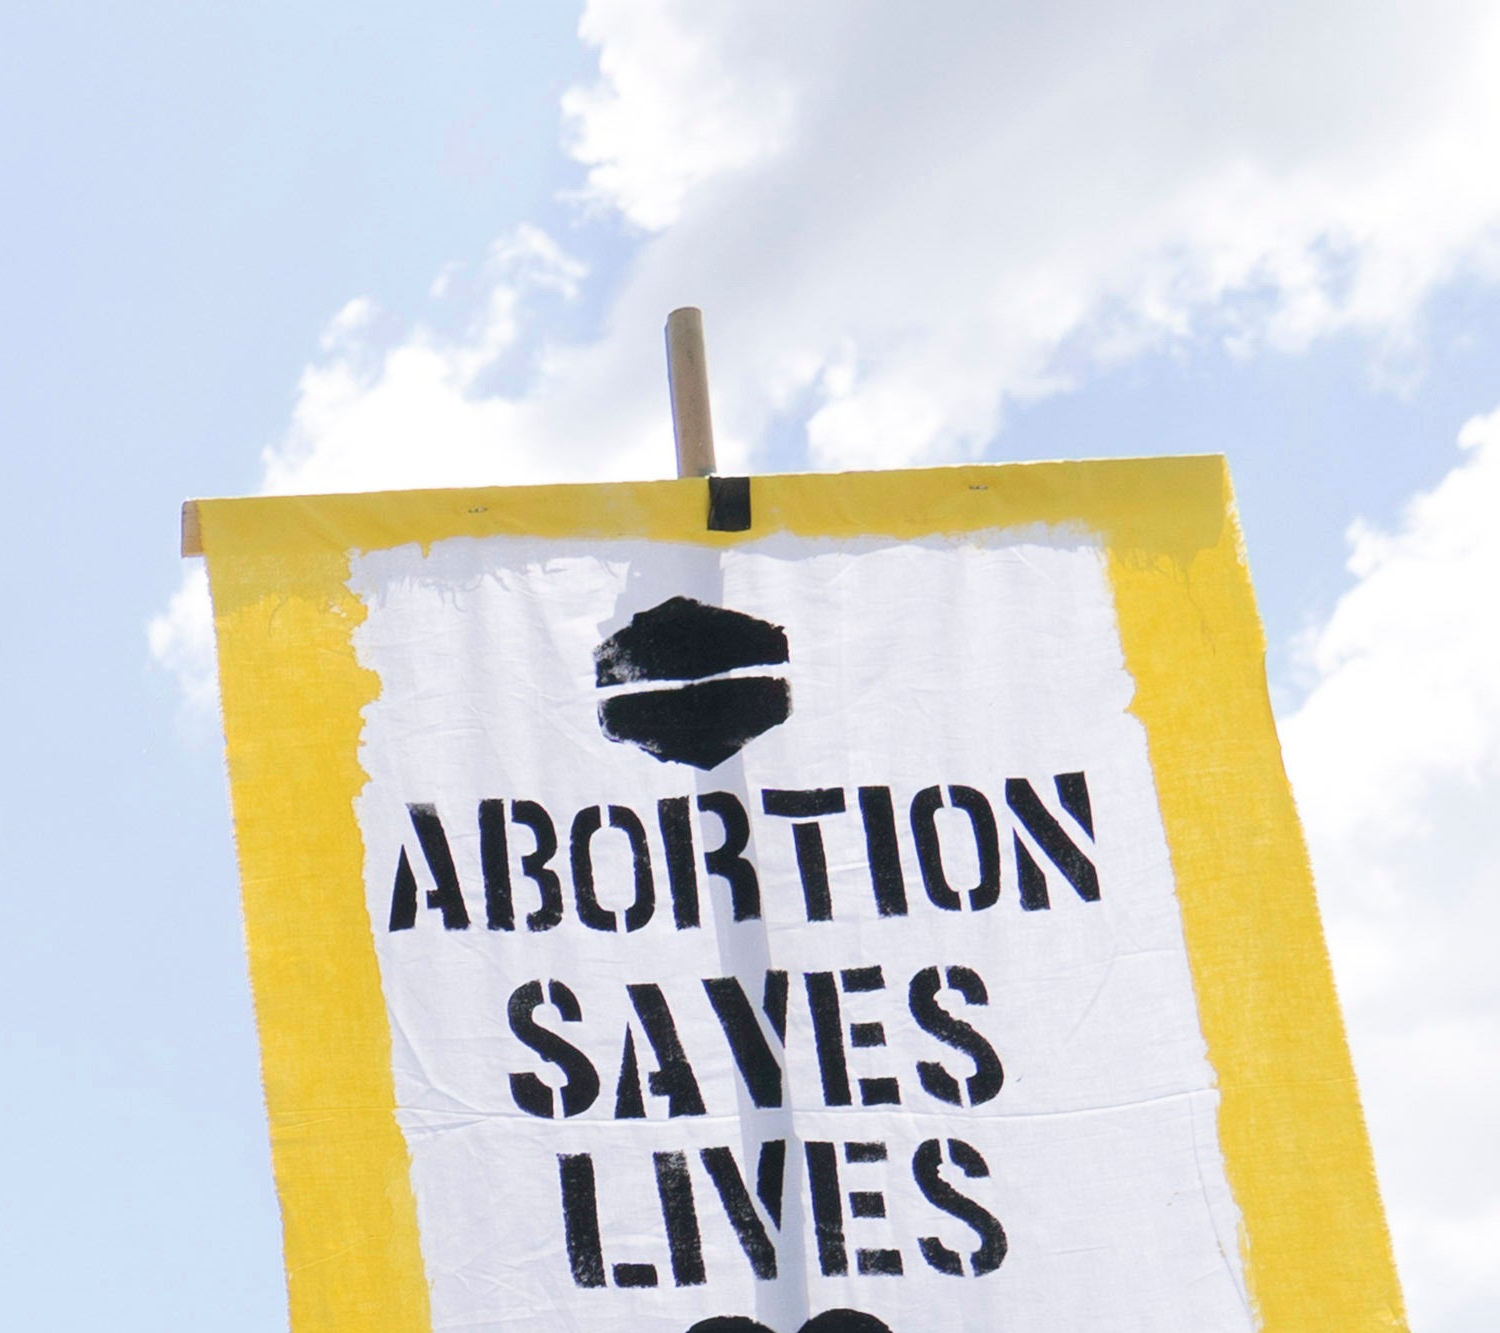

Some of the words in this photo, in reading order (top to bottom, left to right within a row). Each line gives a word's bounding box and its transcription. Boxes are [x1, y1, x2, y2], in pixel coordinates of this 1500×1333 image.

[387, 771, 1103, 935] ABORTION
[506, 964, 1005, 1120] SAVES
[556, 1138, 1010, 1290] LIVES
